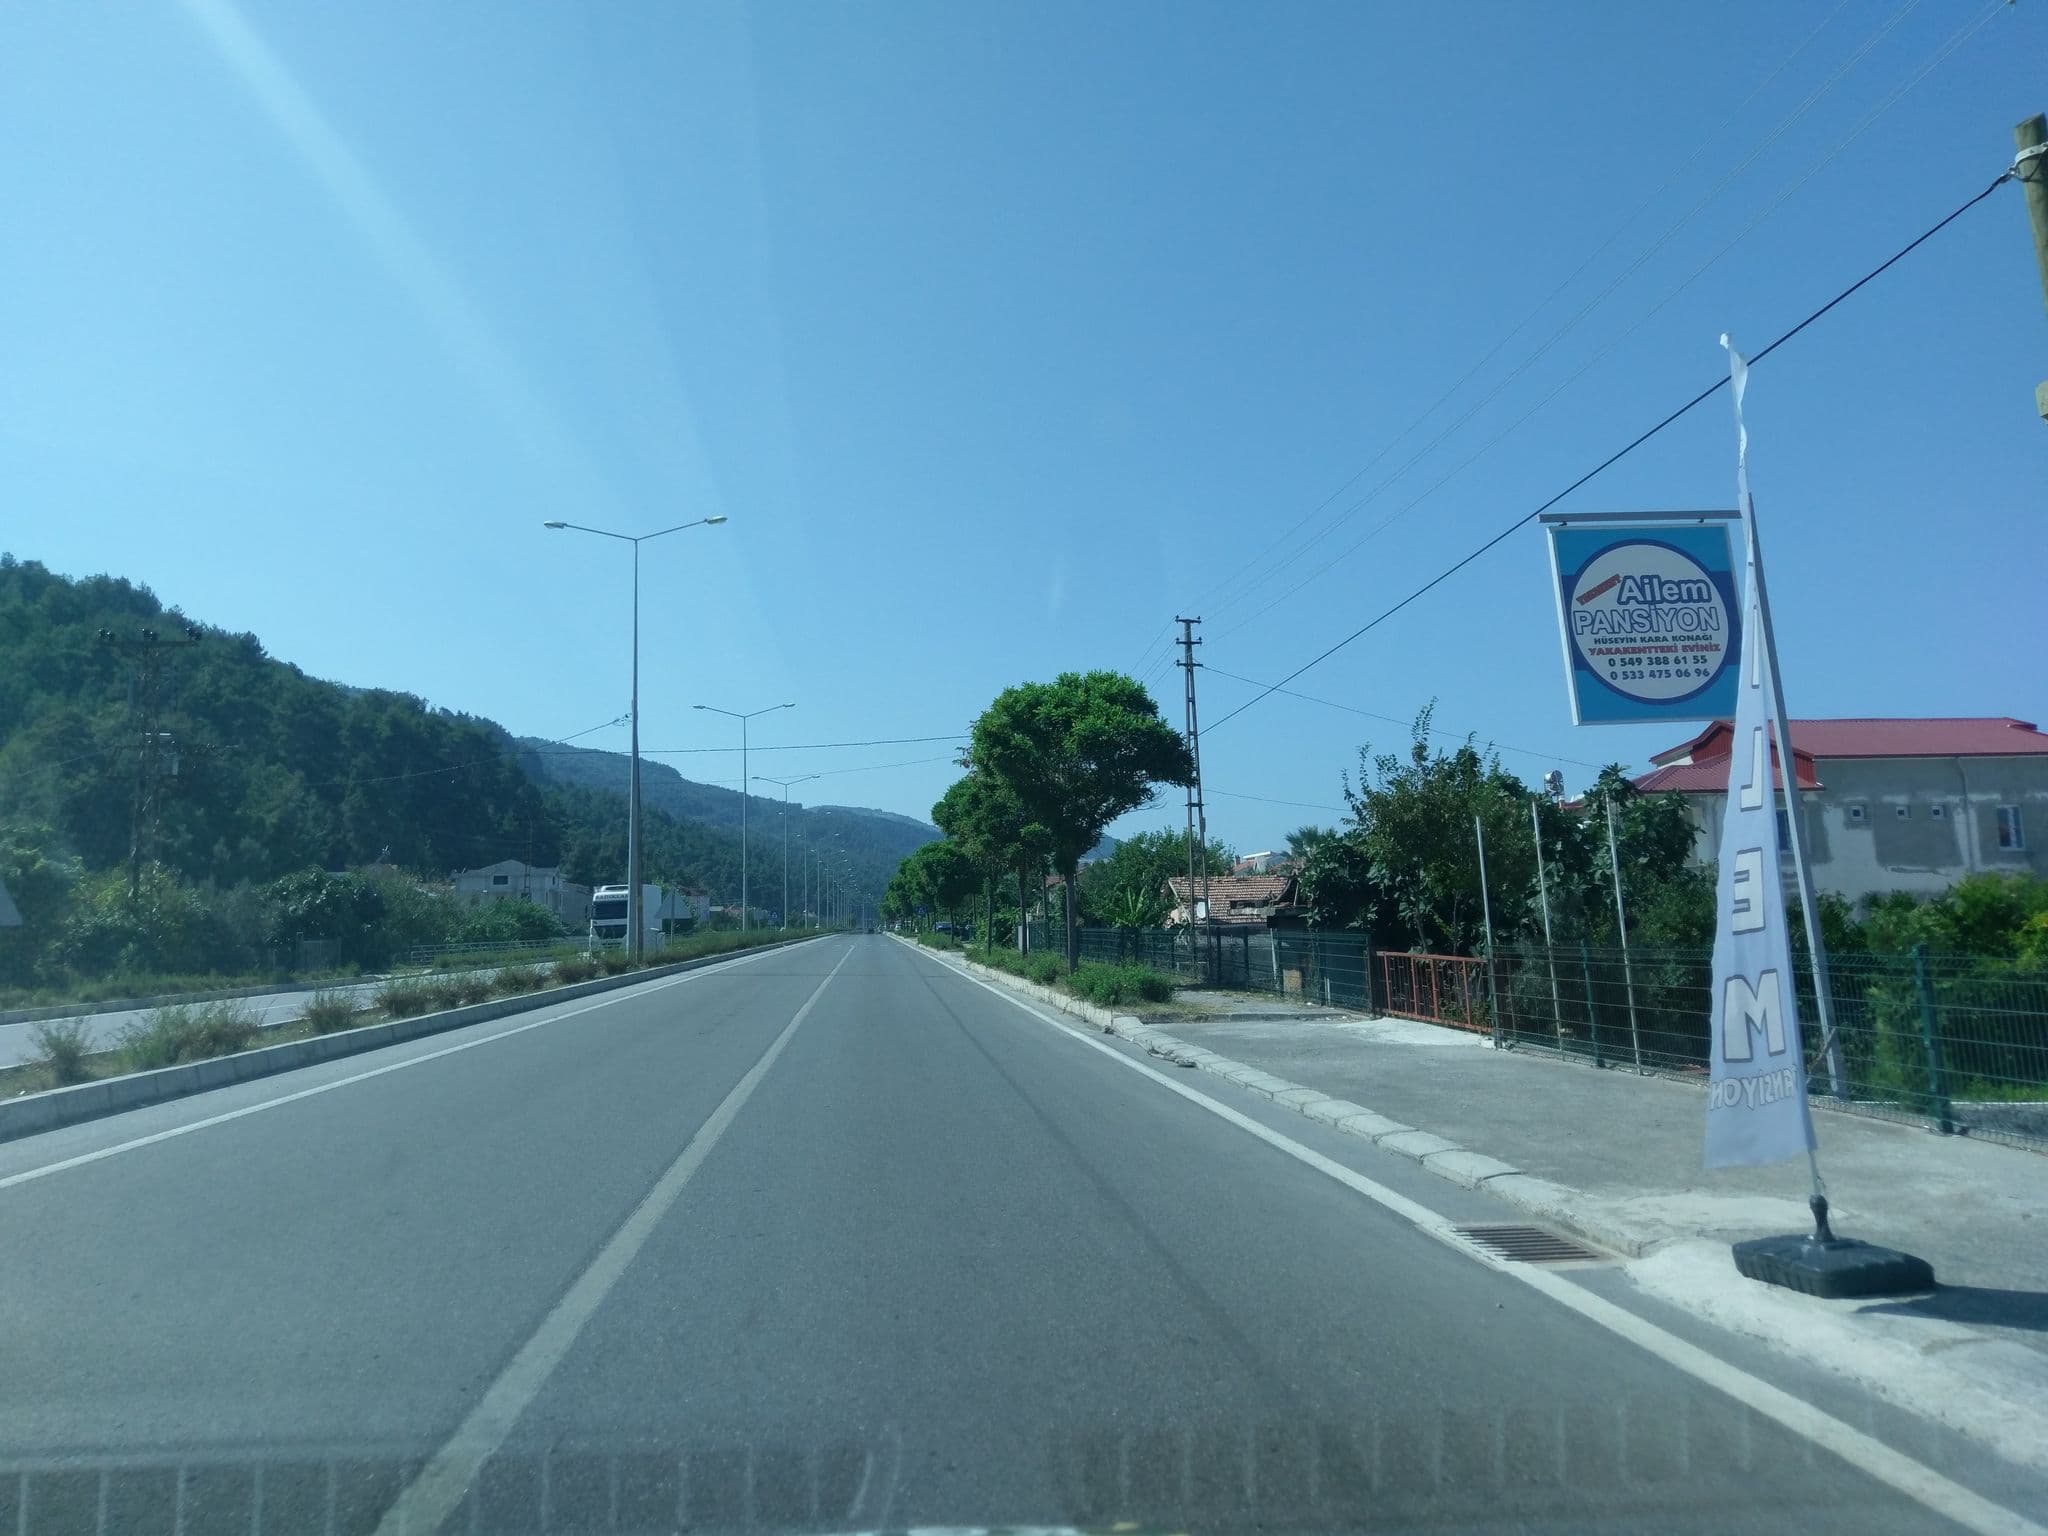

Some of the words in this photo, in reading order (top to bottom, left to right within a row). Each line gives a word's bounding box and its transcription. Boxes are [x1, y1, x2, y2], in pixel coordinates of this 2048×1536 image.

[1617, 574, 1712, 605] Ailem
[1573, 603, 1720, 635] PANSİYON
[1640, 635, 1669, 644] KARA
[1608, 657, 1616, 667] 0
[1620, 657, 1643, 667] 549
[1647, 656, 1670, 666] 388
[1674, 655, 1688, 665] 61
[1692, 655, 1708, 664] 55
[1610, 671, 1618, 680] 0
[1622, 670, 1645, 680] 533
[1648, 669, 1672, 679] 475
[1675, 668, 1691, 678] 06
[1694, 667, 1710, 677] 96
